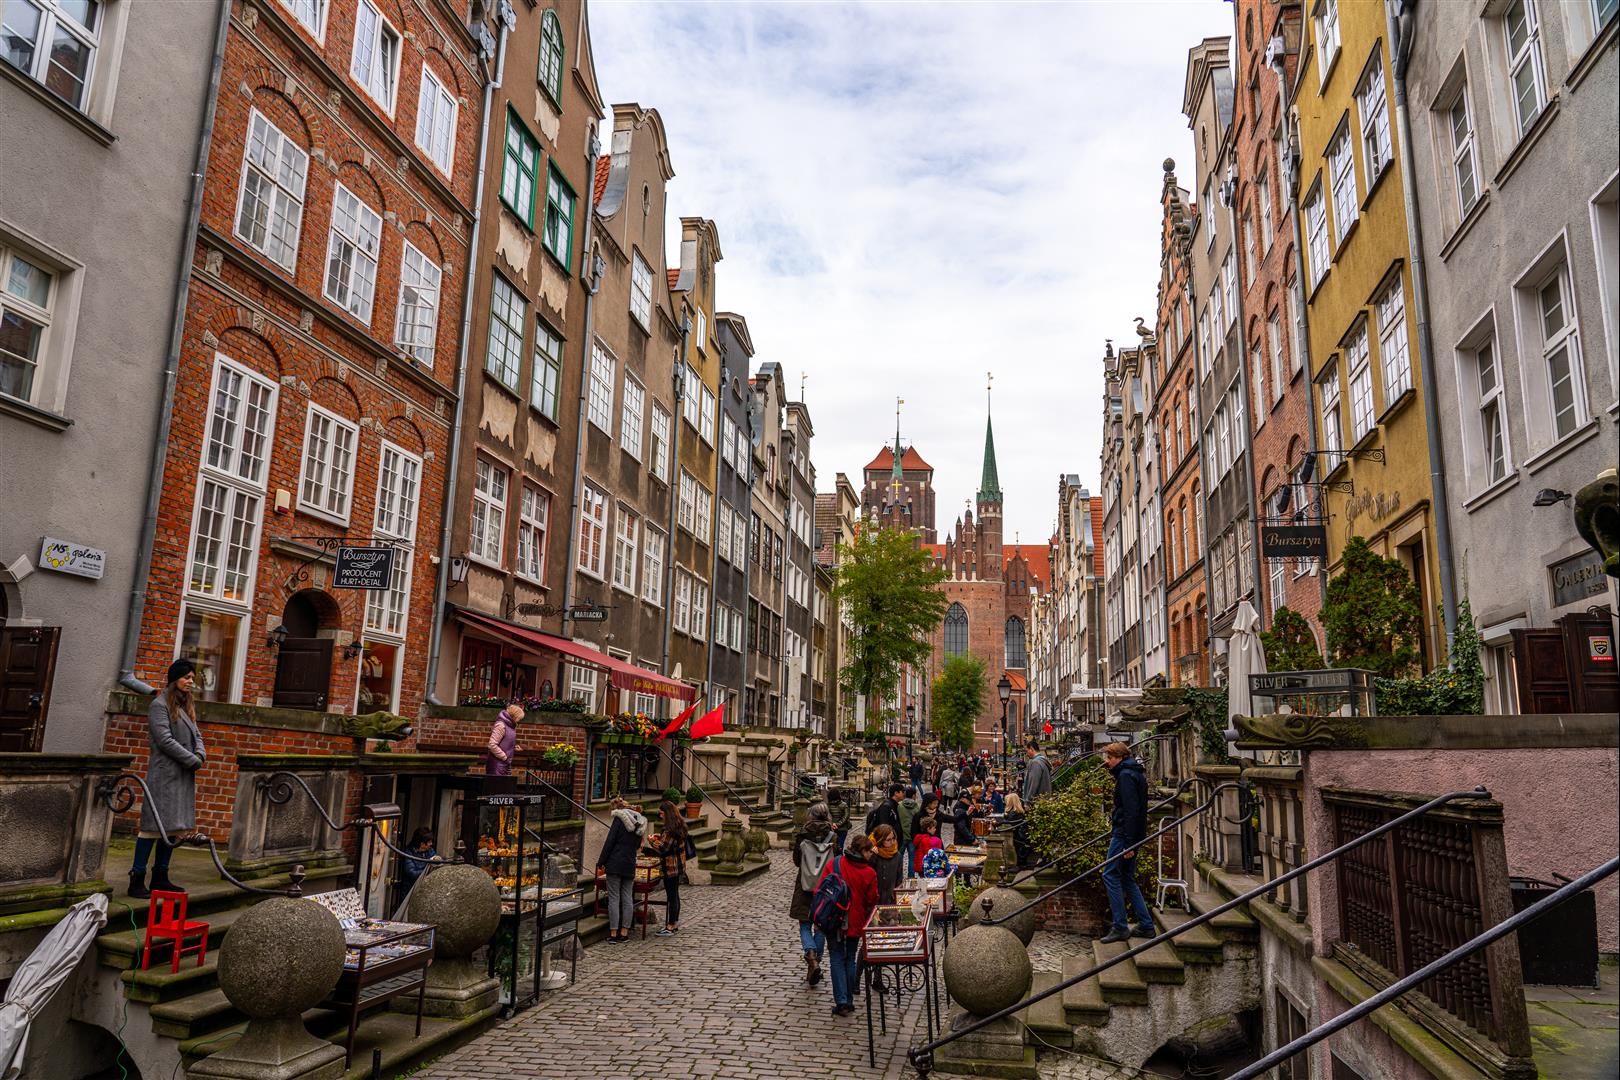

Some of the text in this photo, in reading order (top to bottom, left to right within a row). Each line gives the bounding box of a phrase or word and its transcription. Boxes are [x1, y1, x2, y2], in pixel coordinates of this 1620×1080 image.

[1265, 532, 1321, 549] Bursztyn
[70, 548, 102, 566] galeria
[342, 549, 386, 564] Bursztyn
[341, 569, 382, 578] PRODUCENT
[573, 610, 603, 618] MARIACKA
[1254, 676, 1288, 690] SILVER
[488, 797, 514, 805] SILVER
